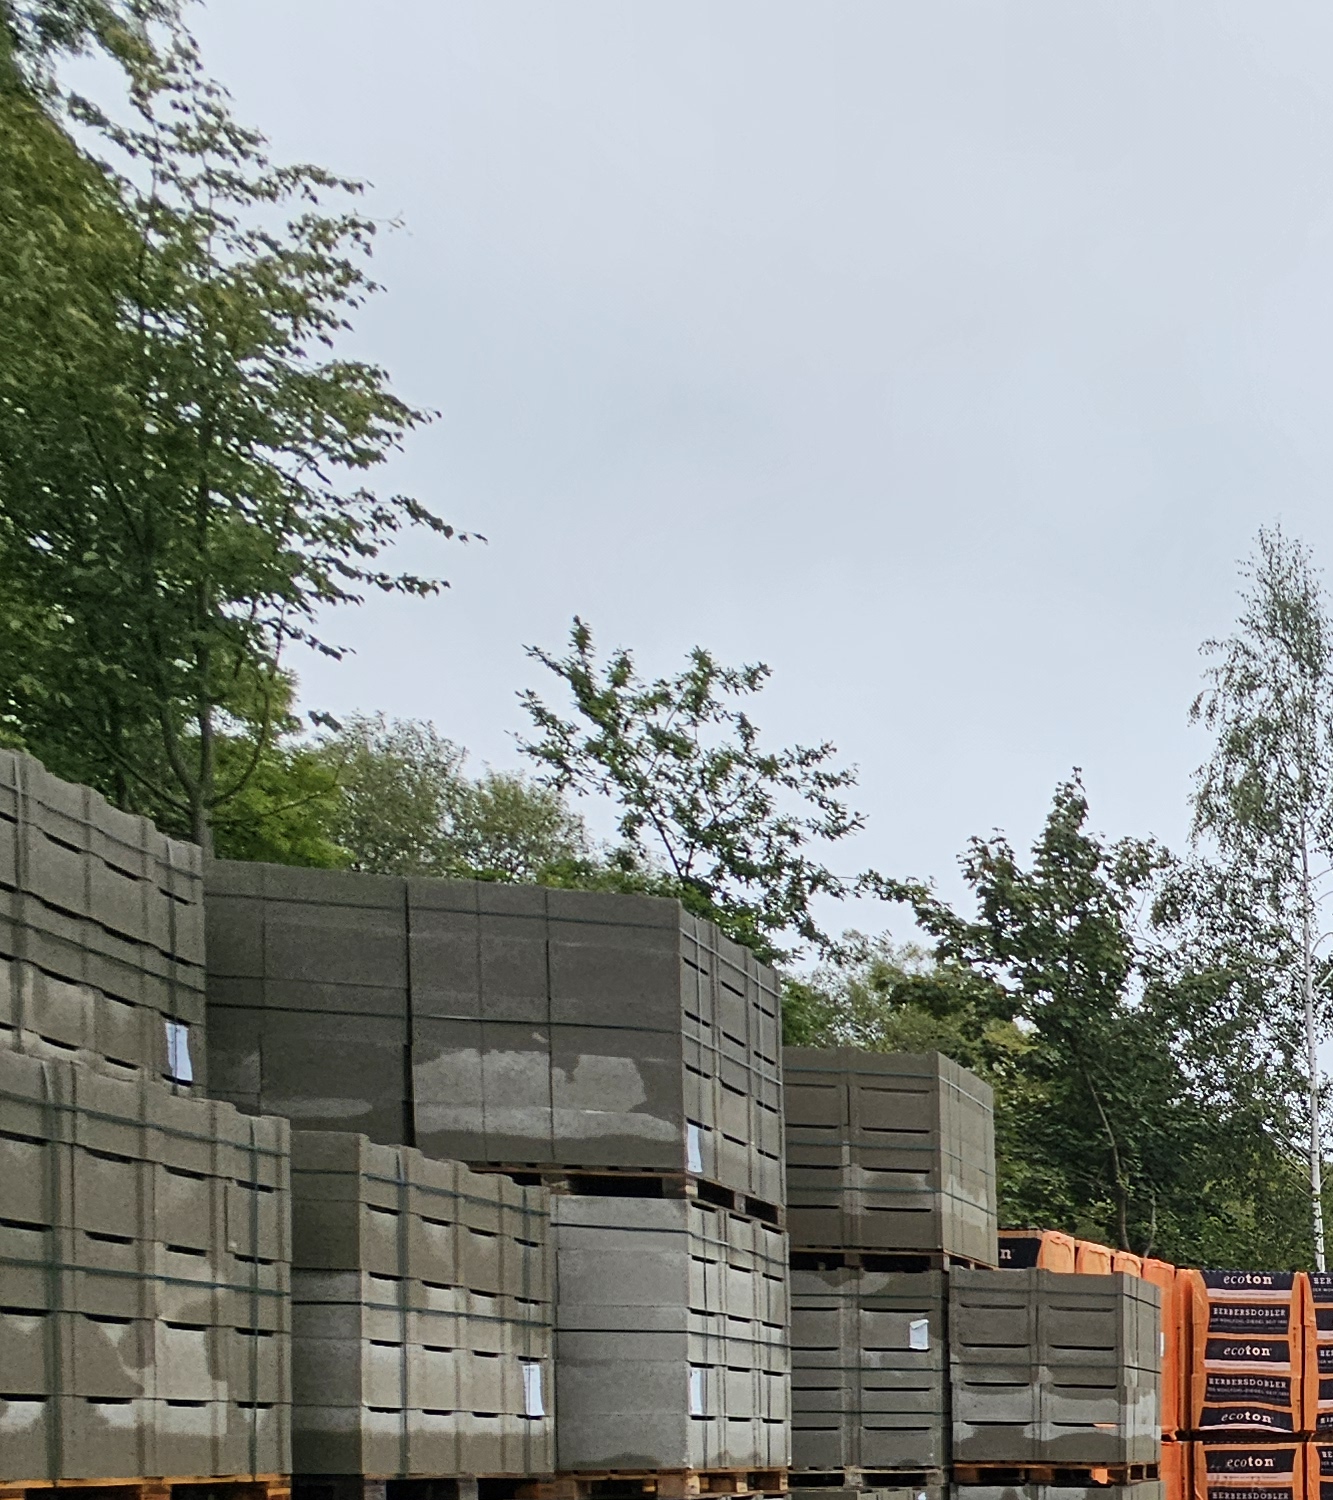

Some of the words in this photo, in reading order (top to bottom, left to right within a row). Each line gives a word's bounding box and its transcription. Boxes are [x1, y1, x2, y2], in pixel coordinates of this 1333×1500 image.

[1223, 1273, 1273, 1285] ecoton
[1223, 1345, 1271, 1356] ecoton
[1221, 1411, 1272, 1424] ecoton
[1226, 1456, 1274, 1468] ecoton
